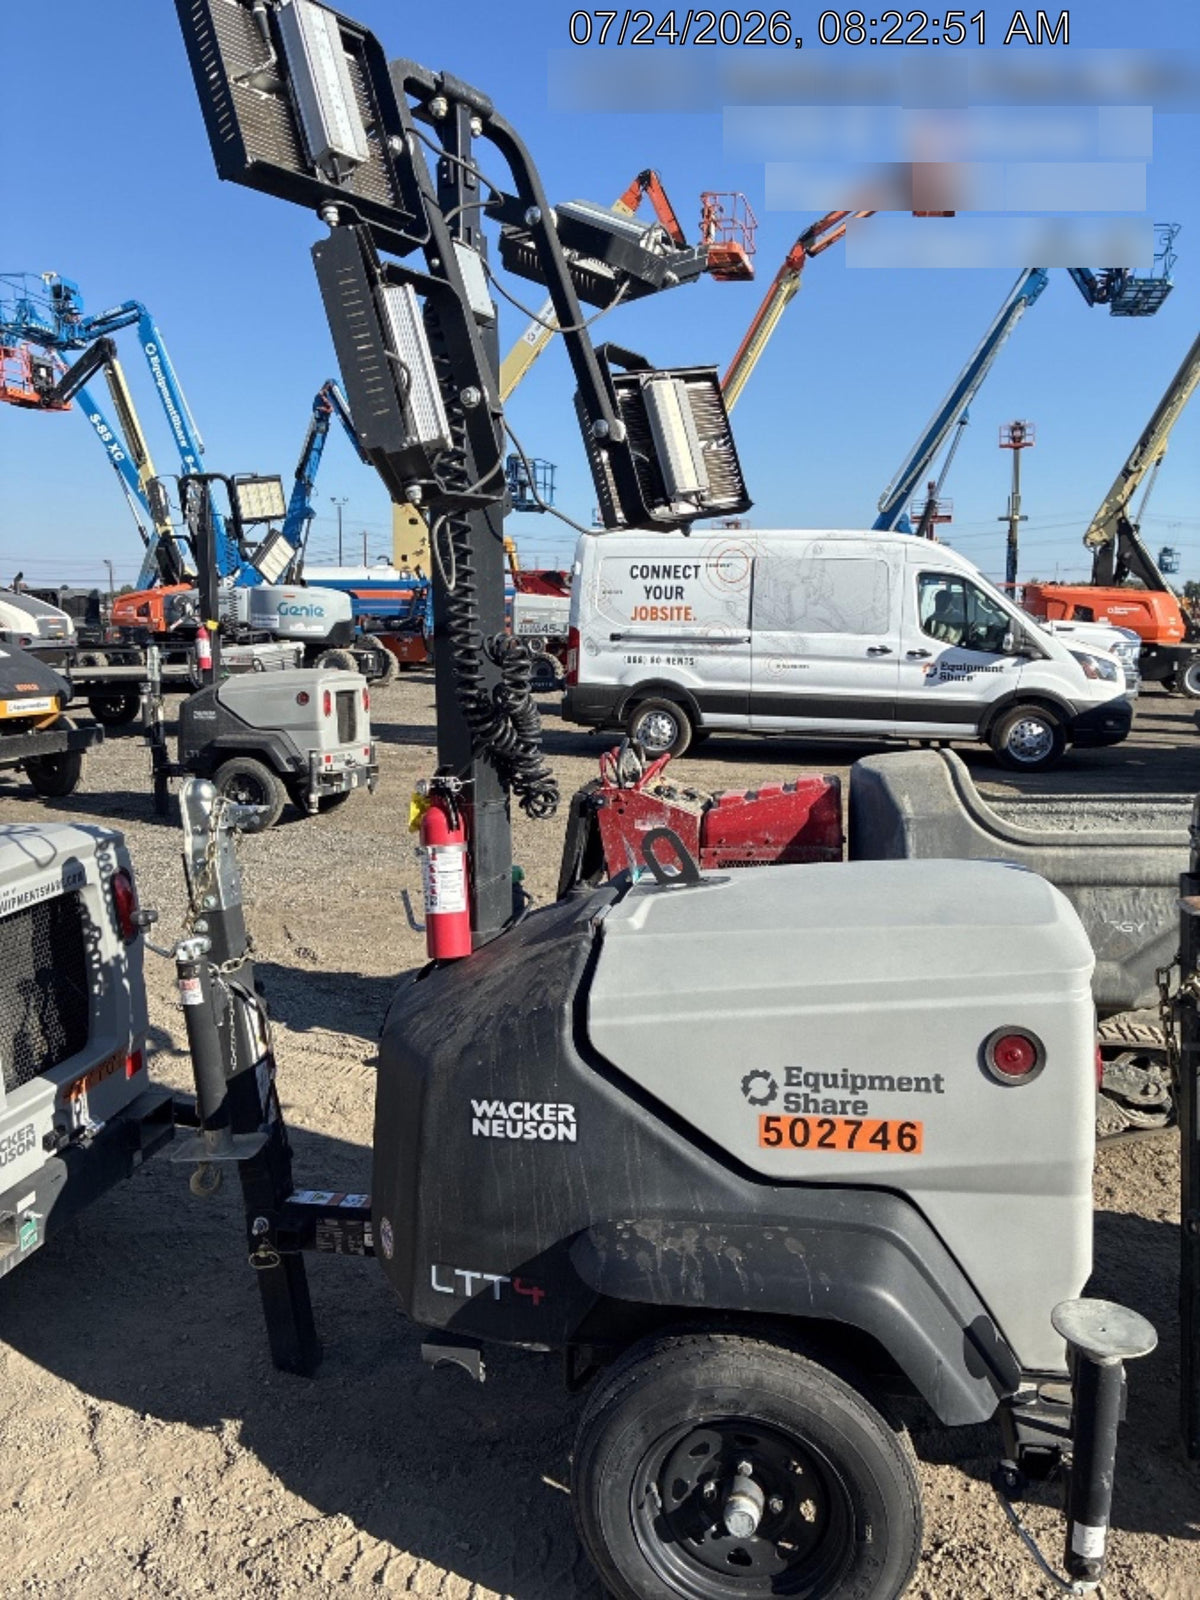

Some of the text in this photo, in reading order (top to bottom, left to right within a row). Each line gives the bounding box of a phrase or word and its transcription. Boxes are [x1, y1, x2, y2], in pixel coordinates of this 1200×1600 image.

[630, 564, 701, 579] CONNECT
[643, 585, 684, 600] YOUR
[277, 602, 325, 617] Genie
[630, 606, 697, 621] JOBSITE.
[940, 661, 1005, 678] Equipment
[784, 1066, 945, 1095] Equipment
[470, 1099, 576, 1122] WACKER
[783, 1092, 869, 1116] Share
[472, 1118, 577, 1142] NEUSON
[763, 1115, 918, 1153] 502746
[431, 1265, 545, 1306] LTT4
